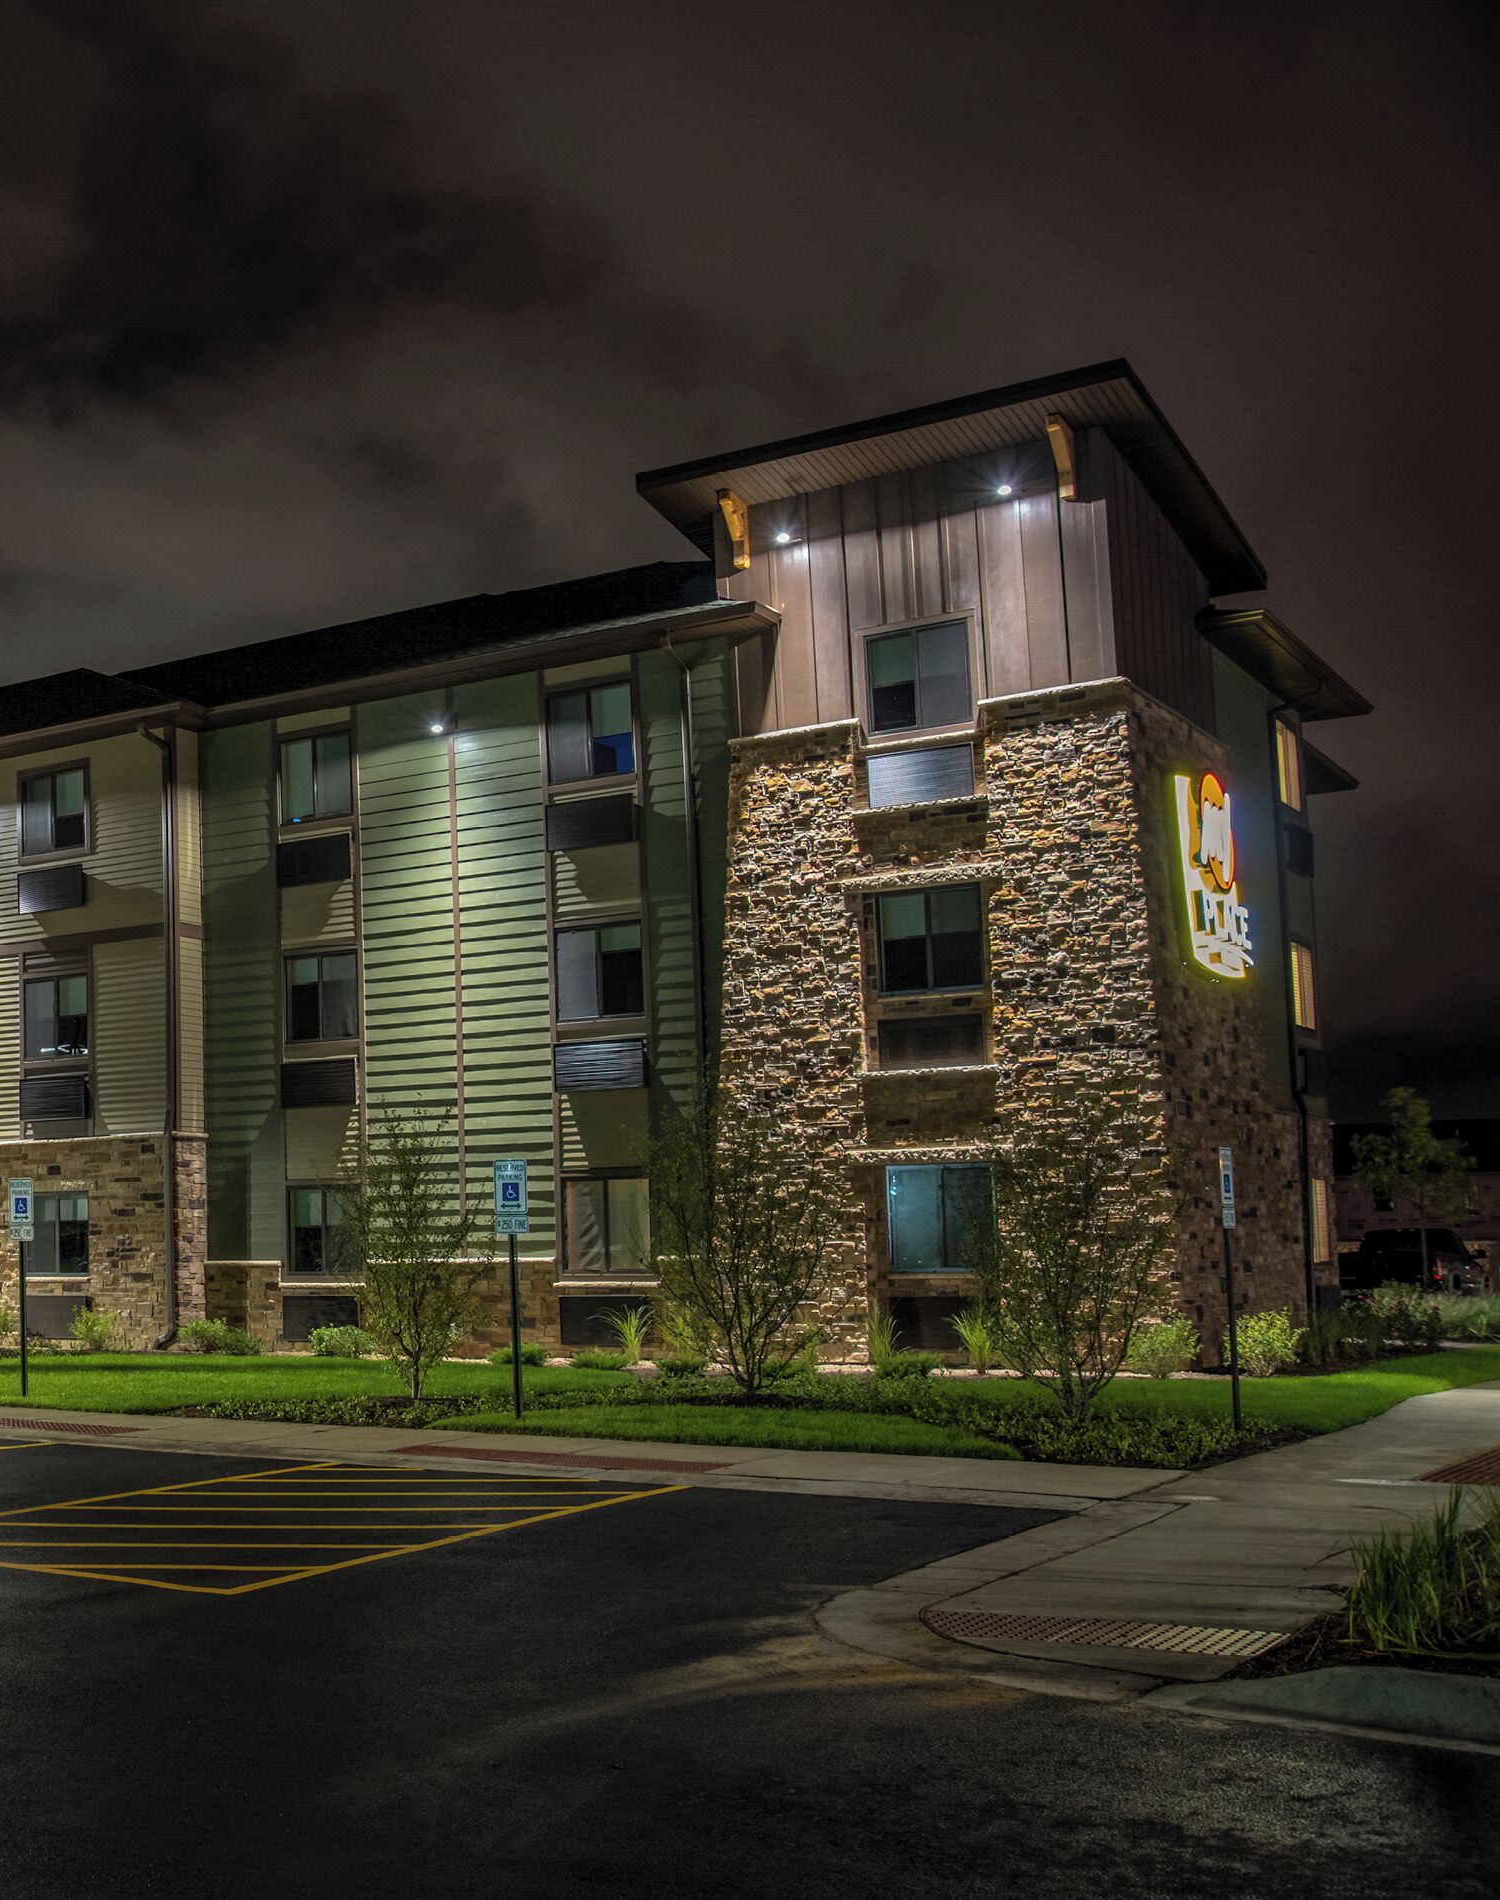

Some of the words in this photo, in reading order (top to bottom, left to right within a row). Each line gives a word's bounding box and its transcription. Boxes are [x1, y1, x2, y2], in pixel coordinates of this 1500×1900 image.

[496, 1164, 524, 1172] RESERVED
[497, 1220, 513, 1230] $250
[515, 1220, 527, 1230] FINE
